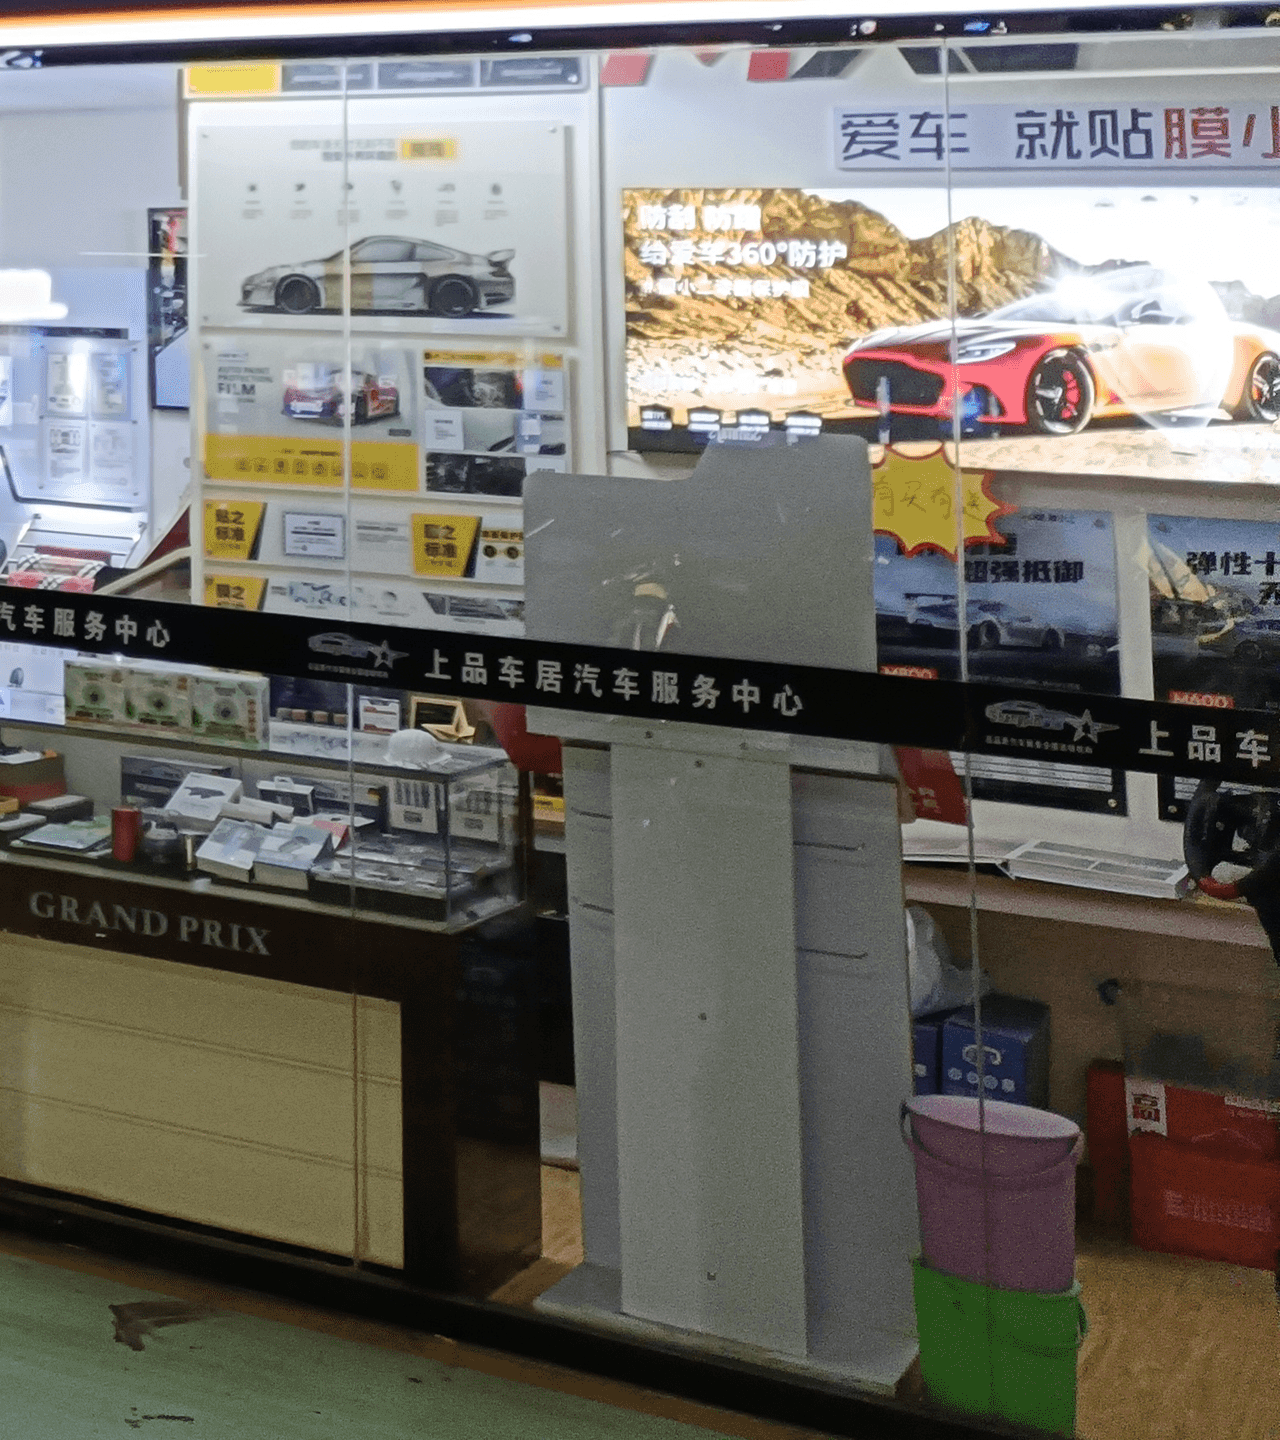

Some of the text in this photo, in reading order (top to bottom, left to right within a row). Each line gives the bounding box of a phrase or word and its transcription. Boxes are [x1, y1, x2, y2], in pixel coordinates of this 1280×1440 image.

[842, 111, 969, 160] 爱车
[217, 382, 256, 396] FILM
[423, 646, 805, 718] 上品车居汽车服务中心
[1138, 720, 1272, 769] 上品车
[29, 891, 272, 957] GRAND PRIX
